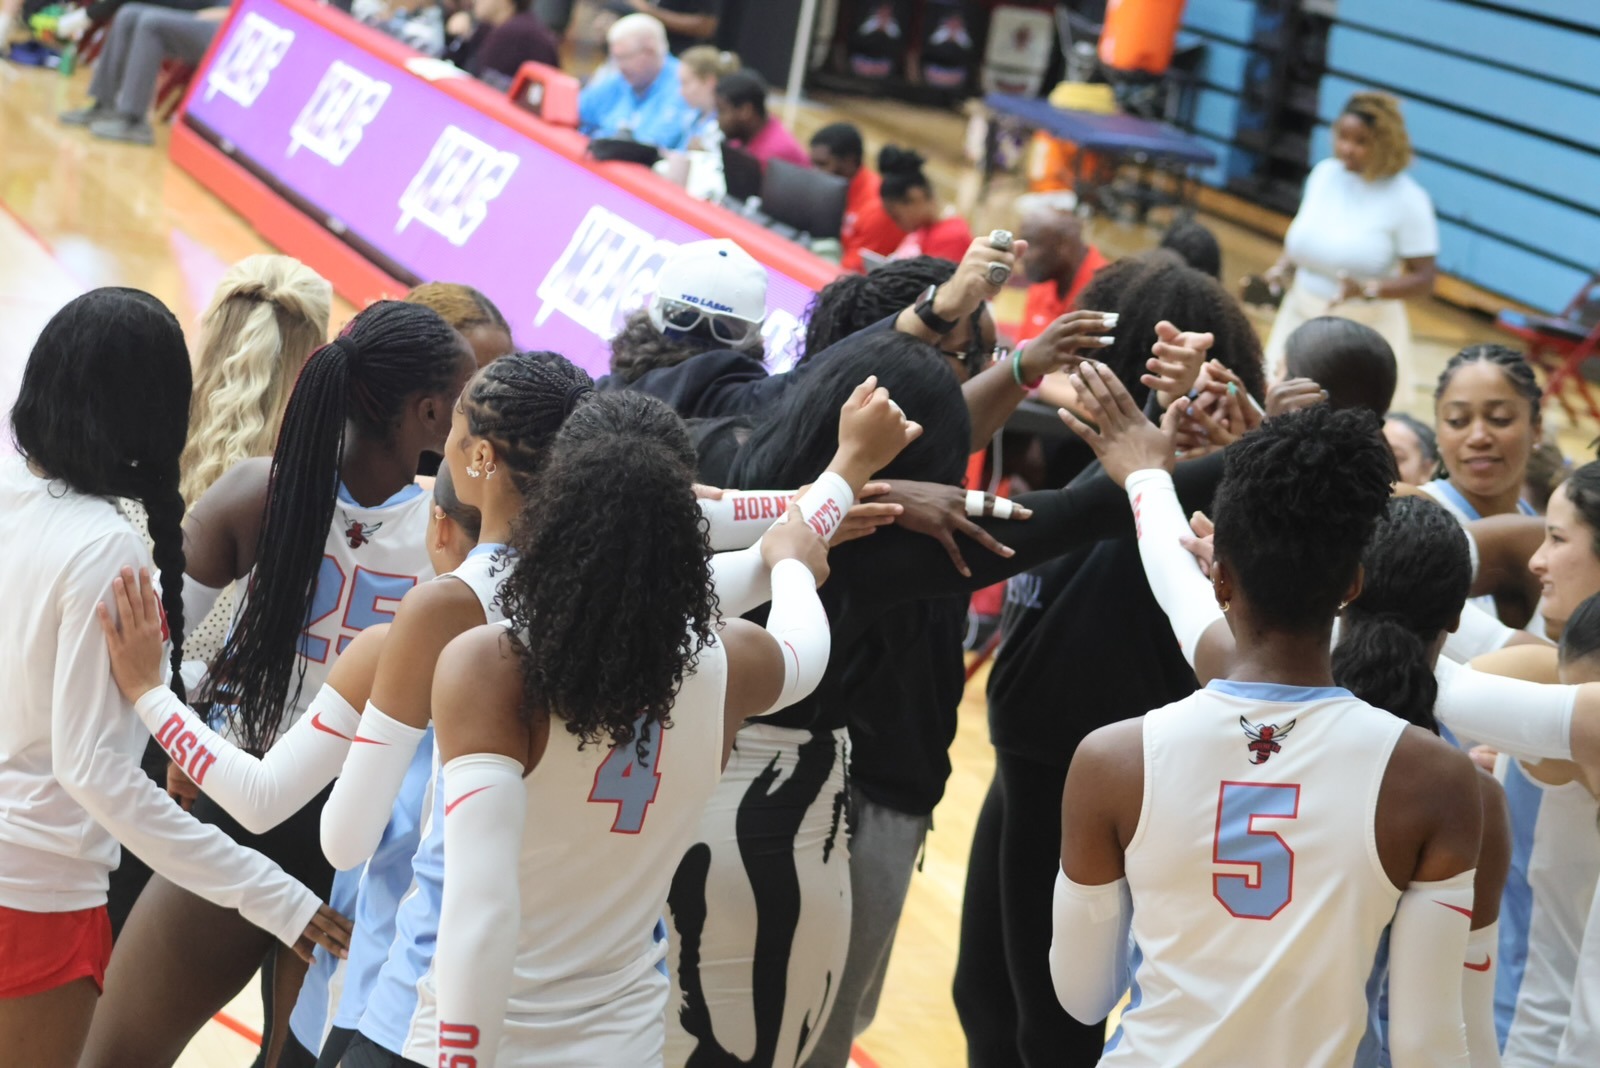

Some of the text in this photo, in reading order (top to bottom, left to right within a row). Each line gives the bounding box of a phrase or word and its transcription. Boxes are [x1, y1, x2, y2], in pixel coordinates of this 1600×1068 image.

[681, 294, 733, 313] TED LASSO
[732, 496, 796, 521] HORN
[155, 712, 217, 785] DSU
[586, 707, 665, 834] 4
[1212, 780, 1301, 920] 5
